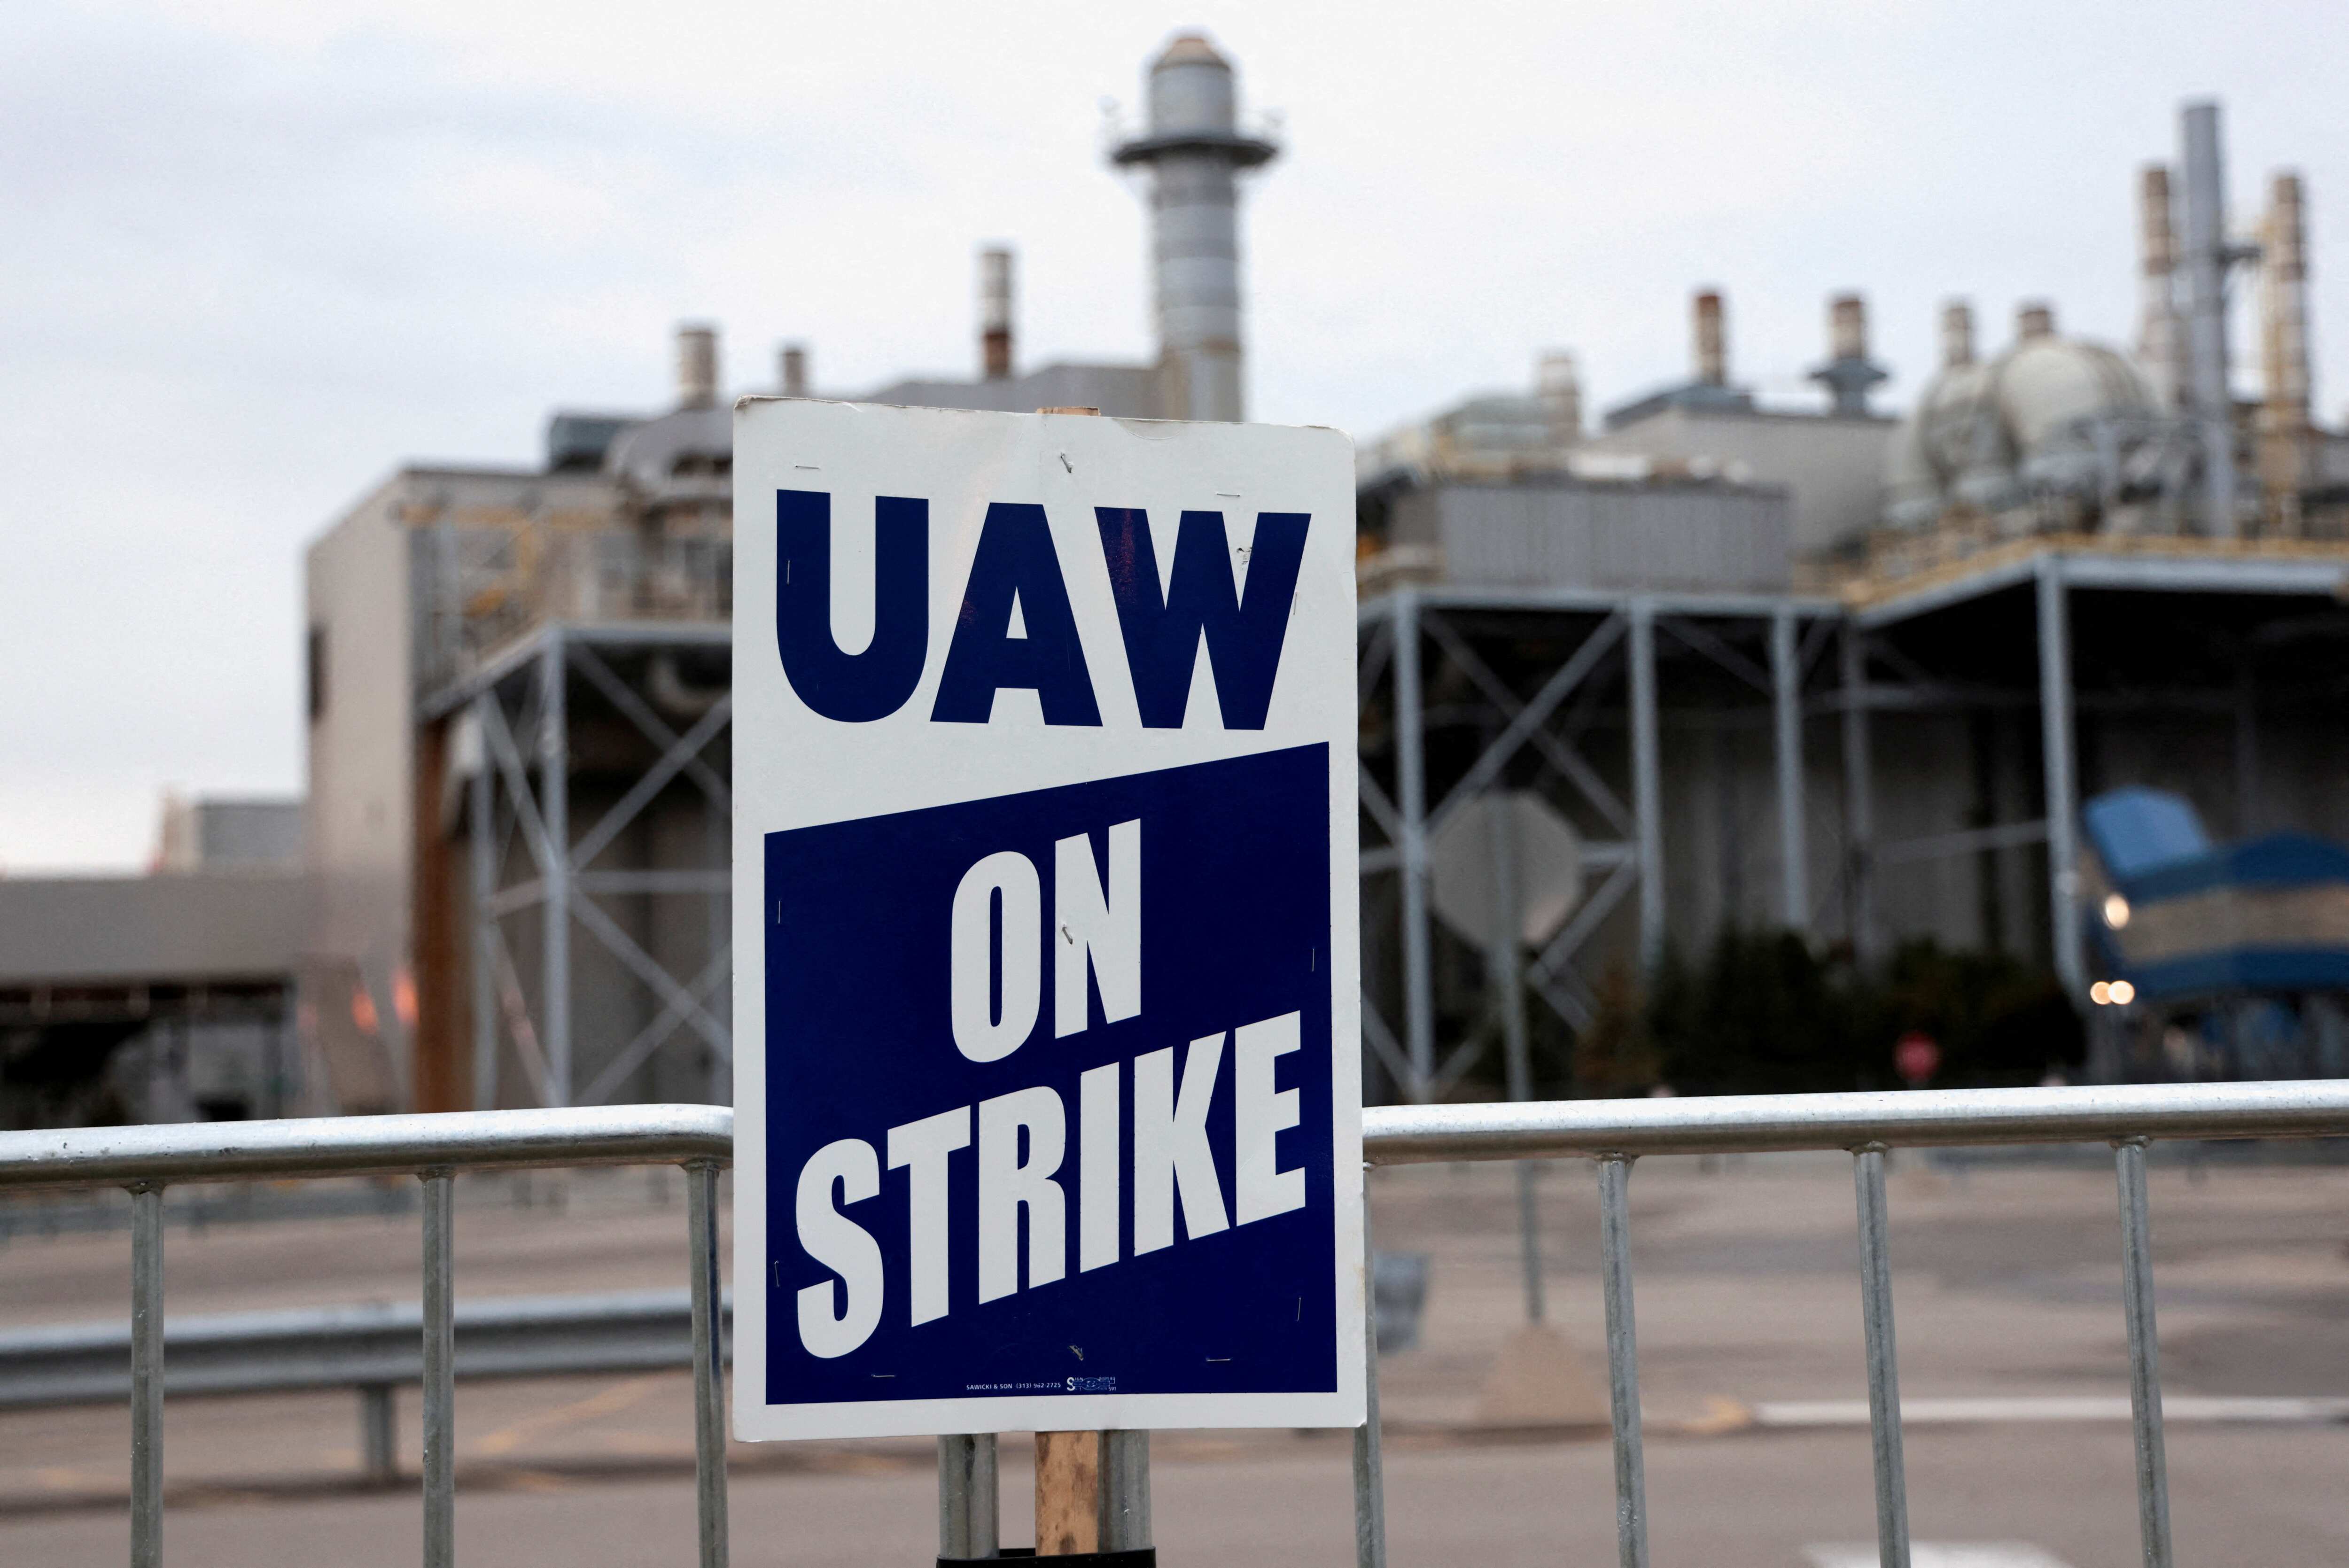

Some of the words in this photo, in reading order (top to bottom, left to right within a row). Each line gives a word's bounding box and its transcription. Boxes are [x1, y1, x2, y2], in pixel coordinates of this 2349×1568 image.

[777, 489, 1311, 730] UAW
[951, 819, 1141, 1062] ON
[796, 1010, 1306, 1358] STRIKE
